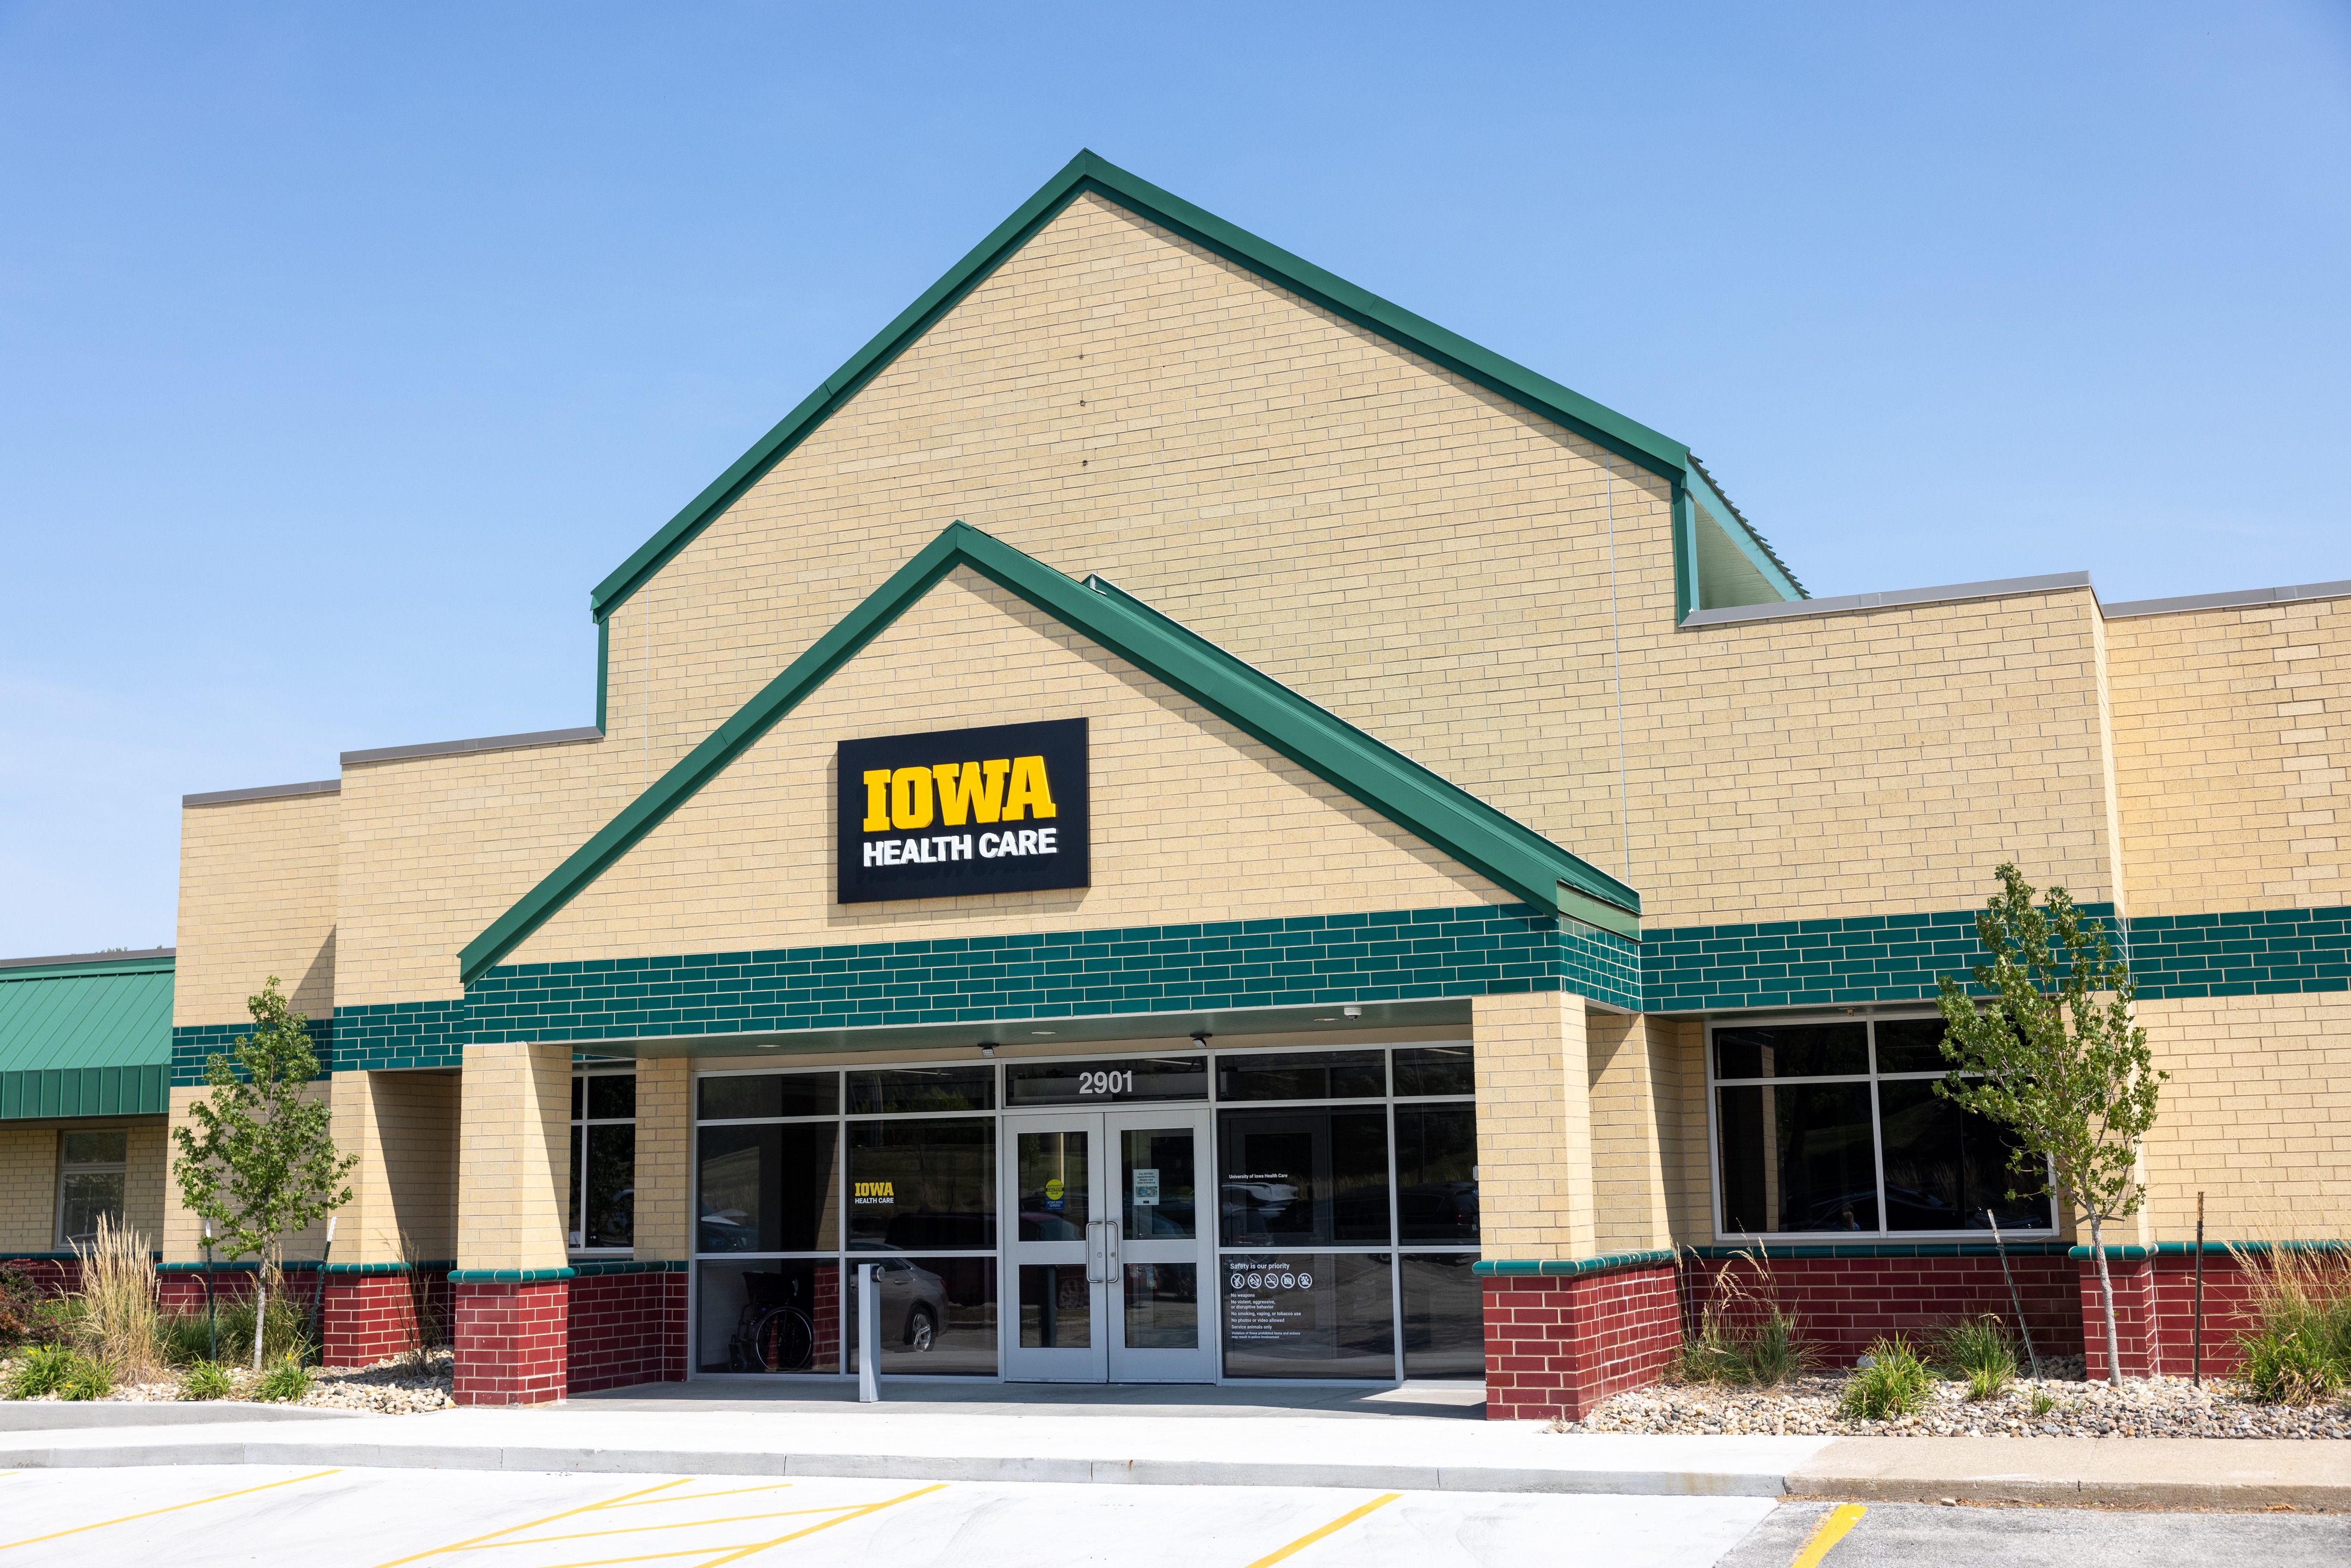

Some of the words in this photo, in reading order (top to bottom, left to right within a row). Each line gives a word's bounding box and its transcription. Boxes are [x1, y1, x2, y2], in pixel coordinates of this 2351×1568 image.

[864, 756, 1056, 832] IOWA
[864, 834, 972, 867] HEALTH
[979, 828, 1058, 858] CARE
[1079, 1070, 1132, 1094] 2901
[855, 1182, 894, 1197] IOWA
